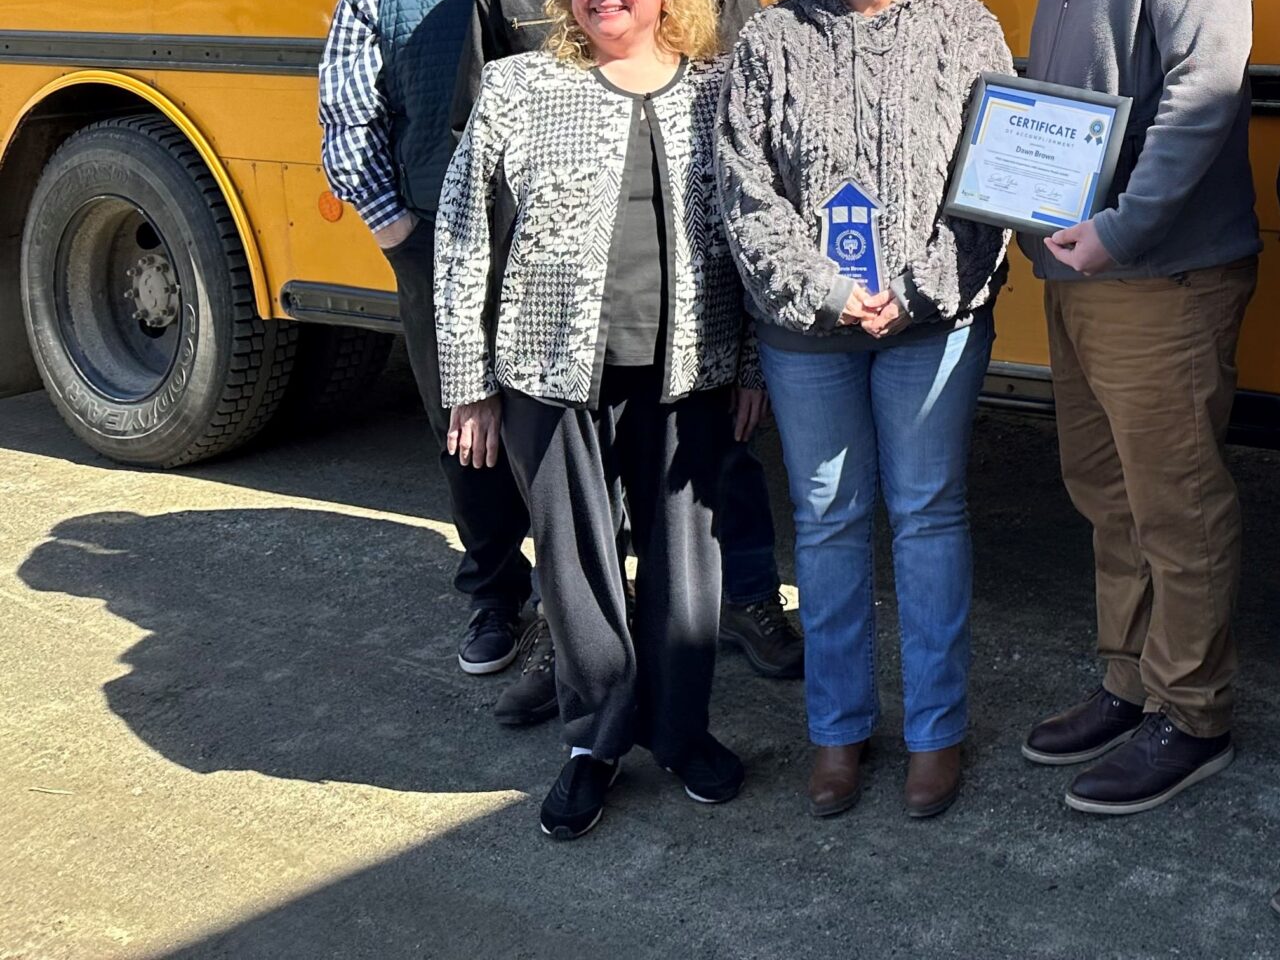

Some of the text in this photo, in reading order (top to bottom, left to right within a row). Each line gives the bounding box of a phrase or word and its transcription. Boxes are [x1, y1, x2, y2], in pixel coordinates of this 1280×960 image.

[1009, 115, 1077, 140] CERTIFICATE
[1015, 145, 1034, 156] Dawn
[1034, 149, 1055, 161] Brown
